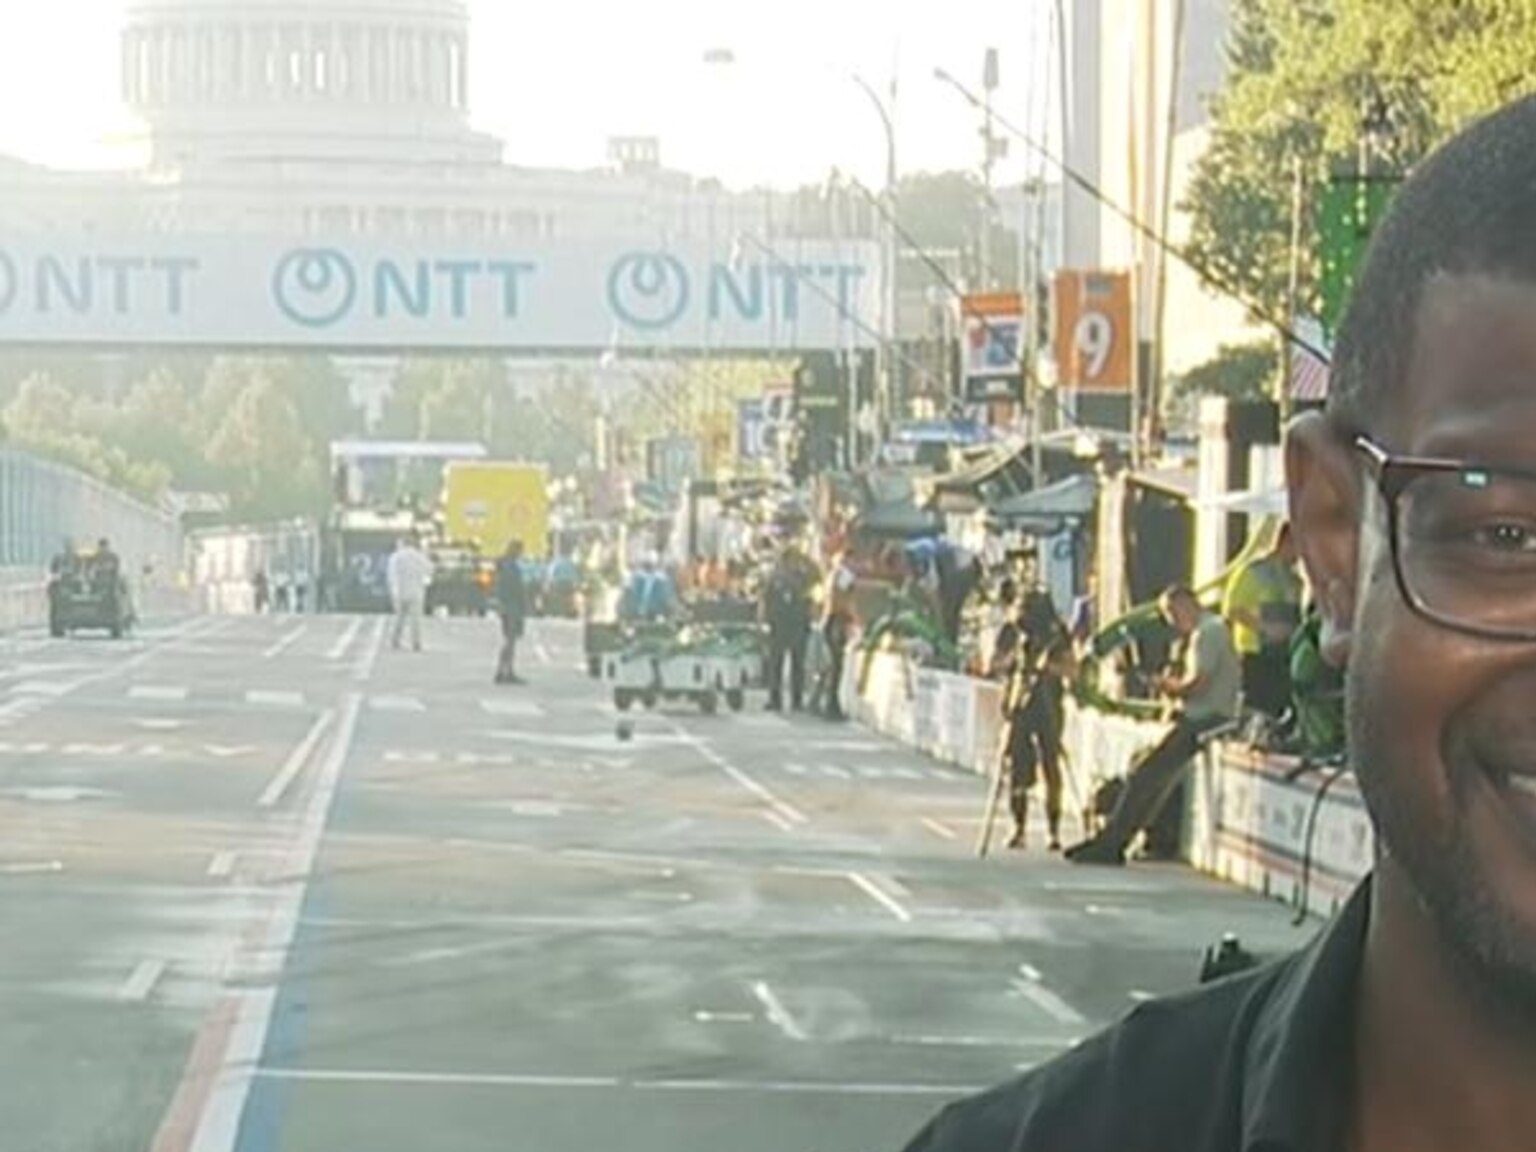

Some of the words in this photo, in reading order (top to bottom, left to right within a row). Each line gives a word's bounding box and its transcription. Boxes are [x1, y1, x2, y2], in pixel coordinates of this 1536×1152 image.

[35, 255, 200, 314] NTT
[373, 260, 536, 318] NTT
[708, 264, 866, 321] NTT
[1074, 313, 1113, 379] 9
